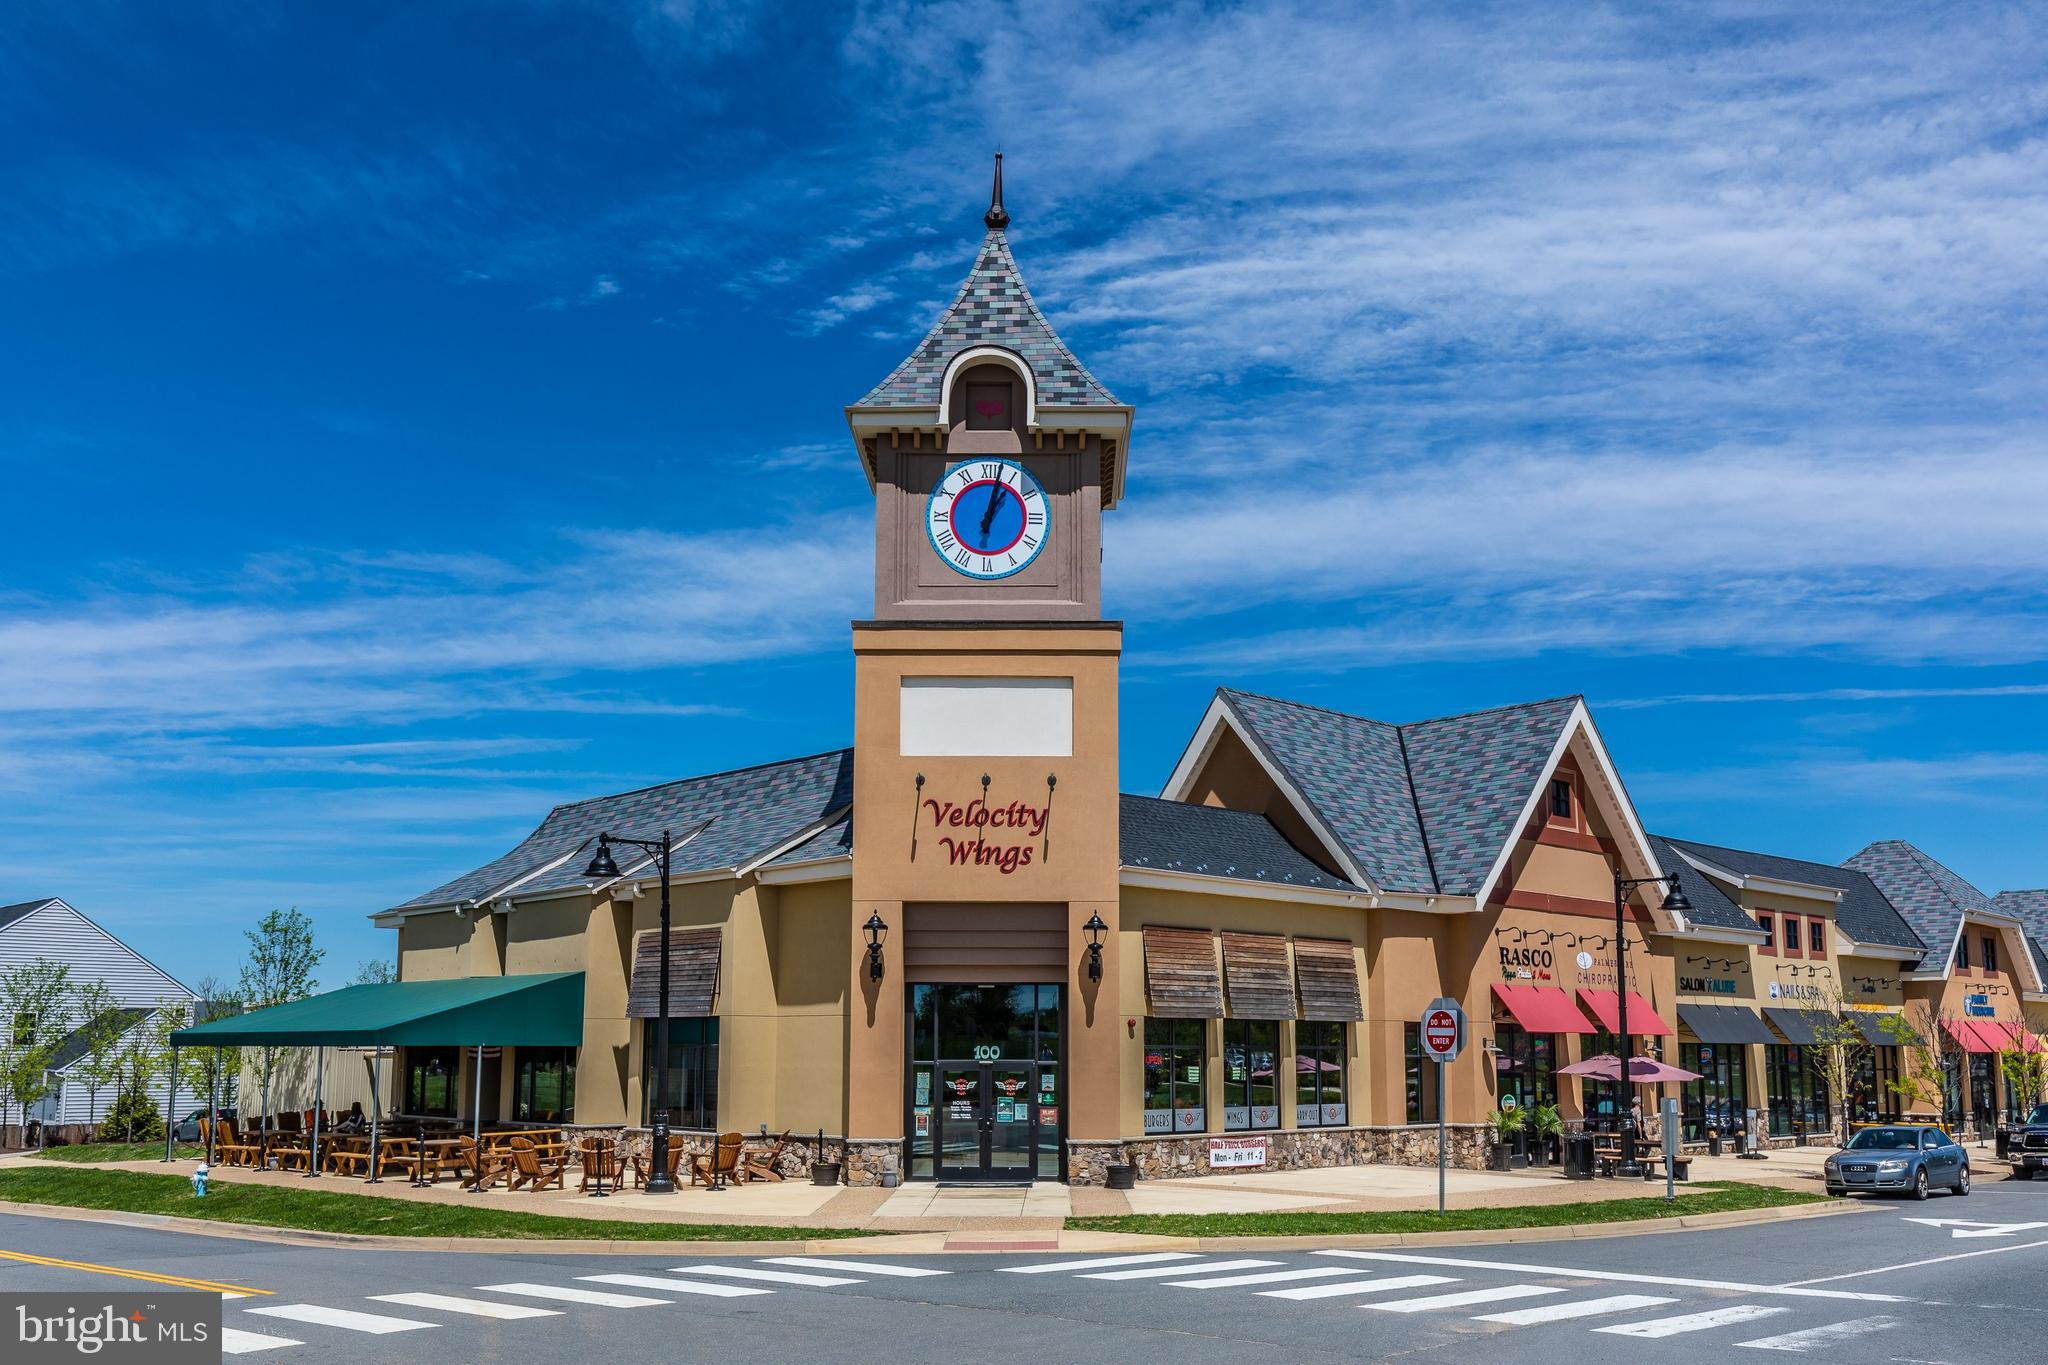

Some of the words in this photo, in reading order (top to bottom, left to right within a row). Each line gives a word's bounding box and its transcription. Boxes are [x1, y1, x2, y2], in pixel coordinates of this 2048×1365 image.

[1028, 512, 1043, 525] III
[922, 799, 1048, 837] Velocity
[938, 837, 1034, 874] Wings
[1499, 946, 1552, 968] RASCO
[1577, 972, 1637, 987] CHIROPRATIC
[1680, 977, 1705, 992] SALON
[1779, 984, 1800, 999] NAILS
[1801, 985, 1807, 999] &
[1807, 986, 1820, 1000] SPA
[1430, 1018, 1439, 1026] DO
[1441, 1018, 1452, 1026] NOT
[1432, 1037, 1450, 1045] ENTER
[973, 1045, 1000, 1059] 100
[1144, 1113, 1170, 1127] BURGERS
[1226, 1111, 1244, 1124] WINGS
[1214, 1153, 1227, 1162] Mon
[1234, 1152, 1243, 1161] Fri
[1247, 1151, 1254, 1160] 11
[1258, 1151, 1263, 1160] 2
